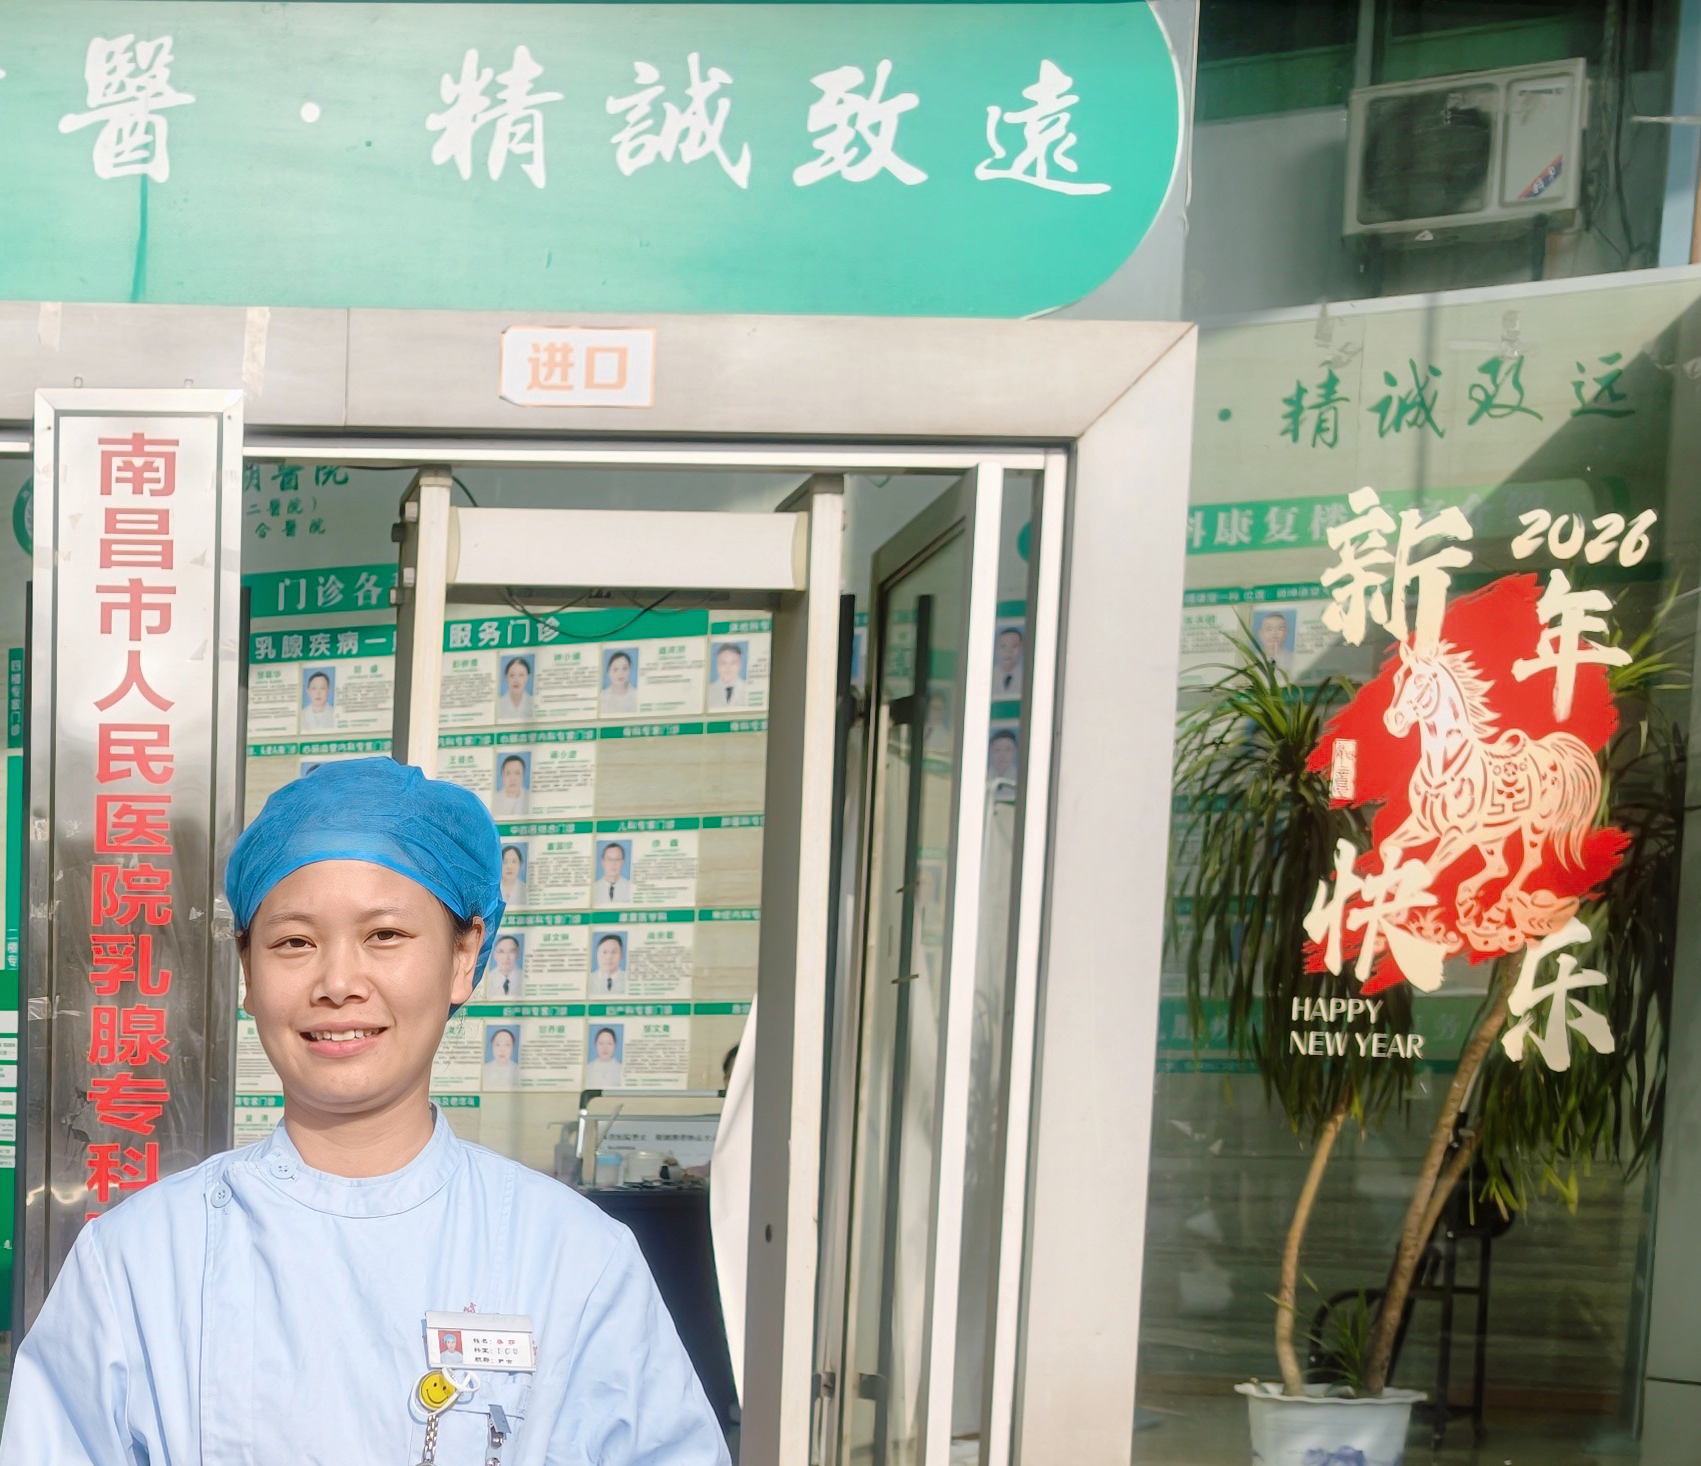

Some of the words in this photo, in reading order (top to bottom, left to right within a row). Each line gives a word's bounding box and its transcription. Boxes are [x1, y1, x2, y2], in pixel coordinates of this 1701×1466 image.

[526, 341, 629, 392] 进口
[1510, 507, 1659, 568] 2026
[276, 571, 398, 612] 门诊各
[254, 630, 397, 660] 乳腺疾病一
[449, 616, 561, 650] 服务门诊
[85, 432, 180, 1221] 南昌市人民医院乳腺专科
[1291, 995, 1384, 1025] HAPPY
[1289, 1030, 1348, 1058] NEW
[1354, 1031, 1425, 1060] YEAR
